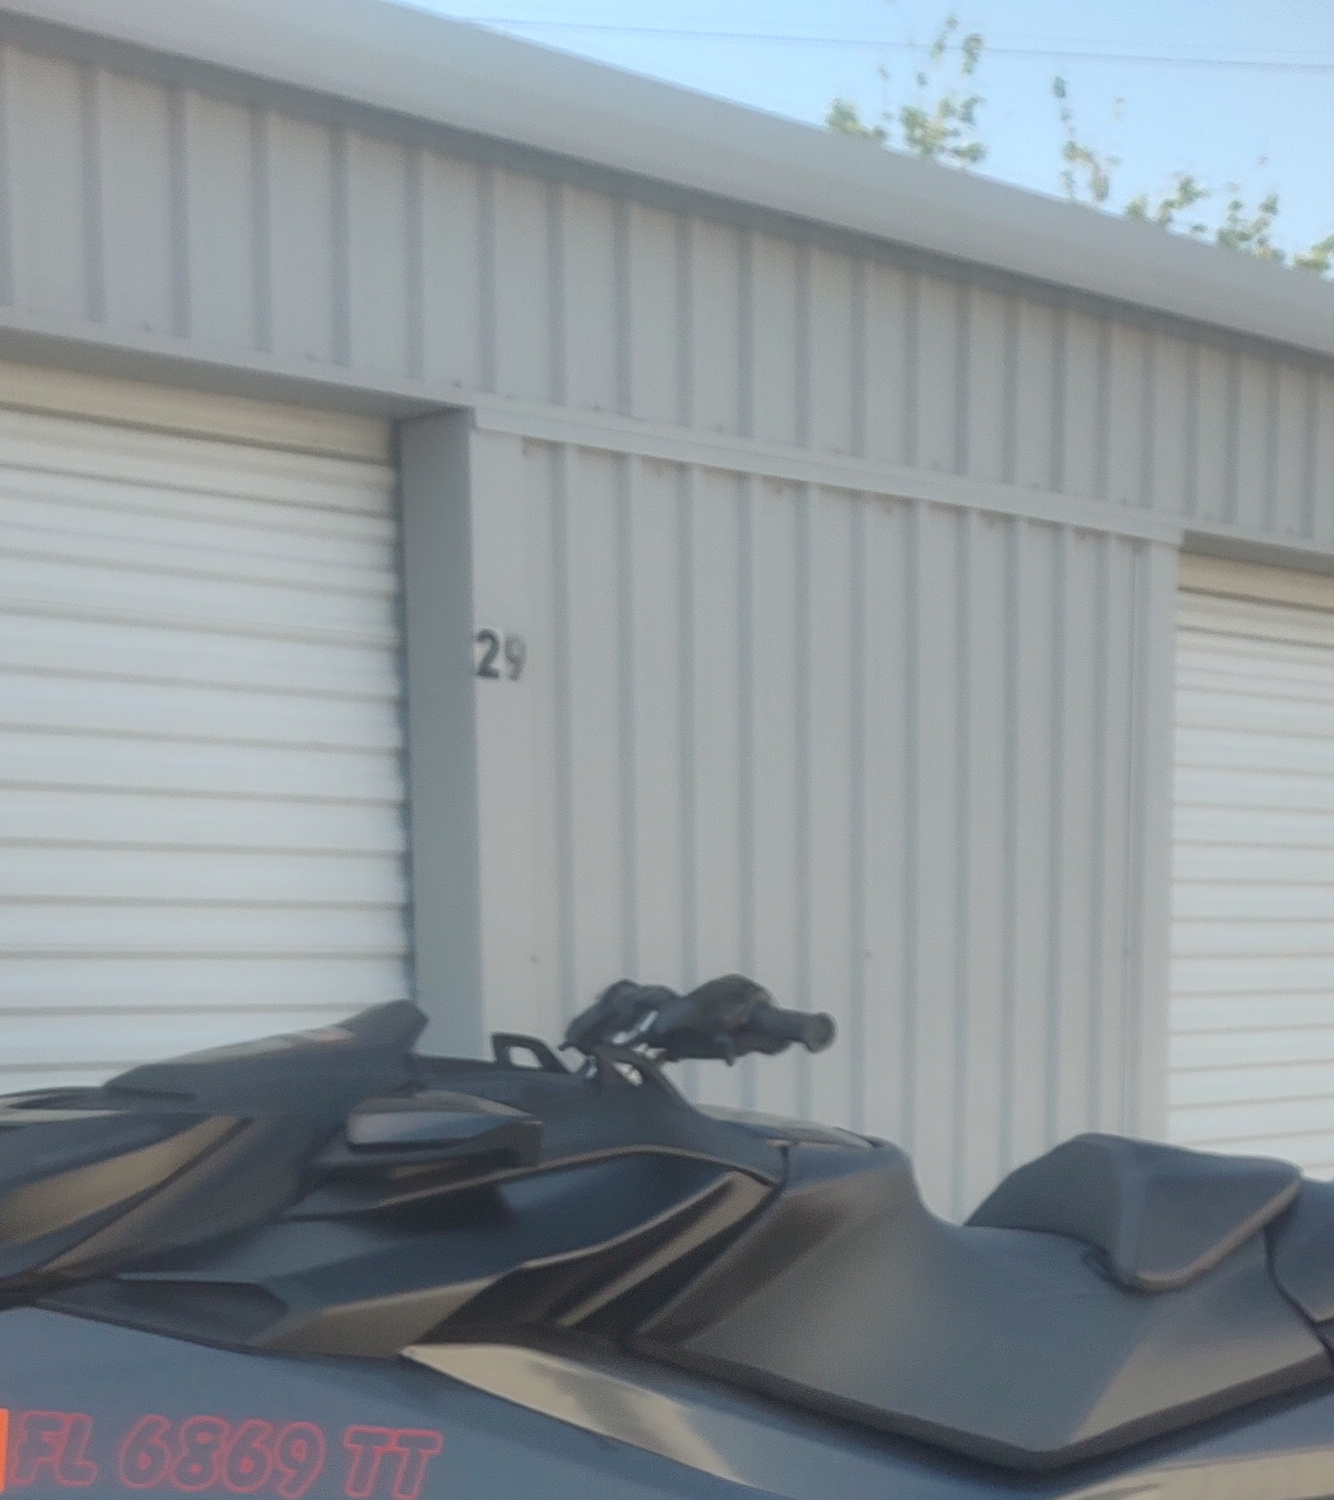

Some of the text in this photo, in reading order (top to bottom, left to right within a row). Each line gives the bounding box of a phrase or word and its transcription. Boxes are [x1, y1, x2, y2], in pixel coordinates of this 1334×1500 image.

[476, 629, 526, 681] 29
[10, 1411, 444, 1500] FL 6869 TT
